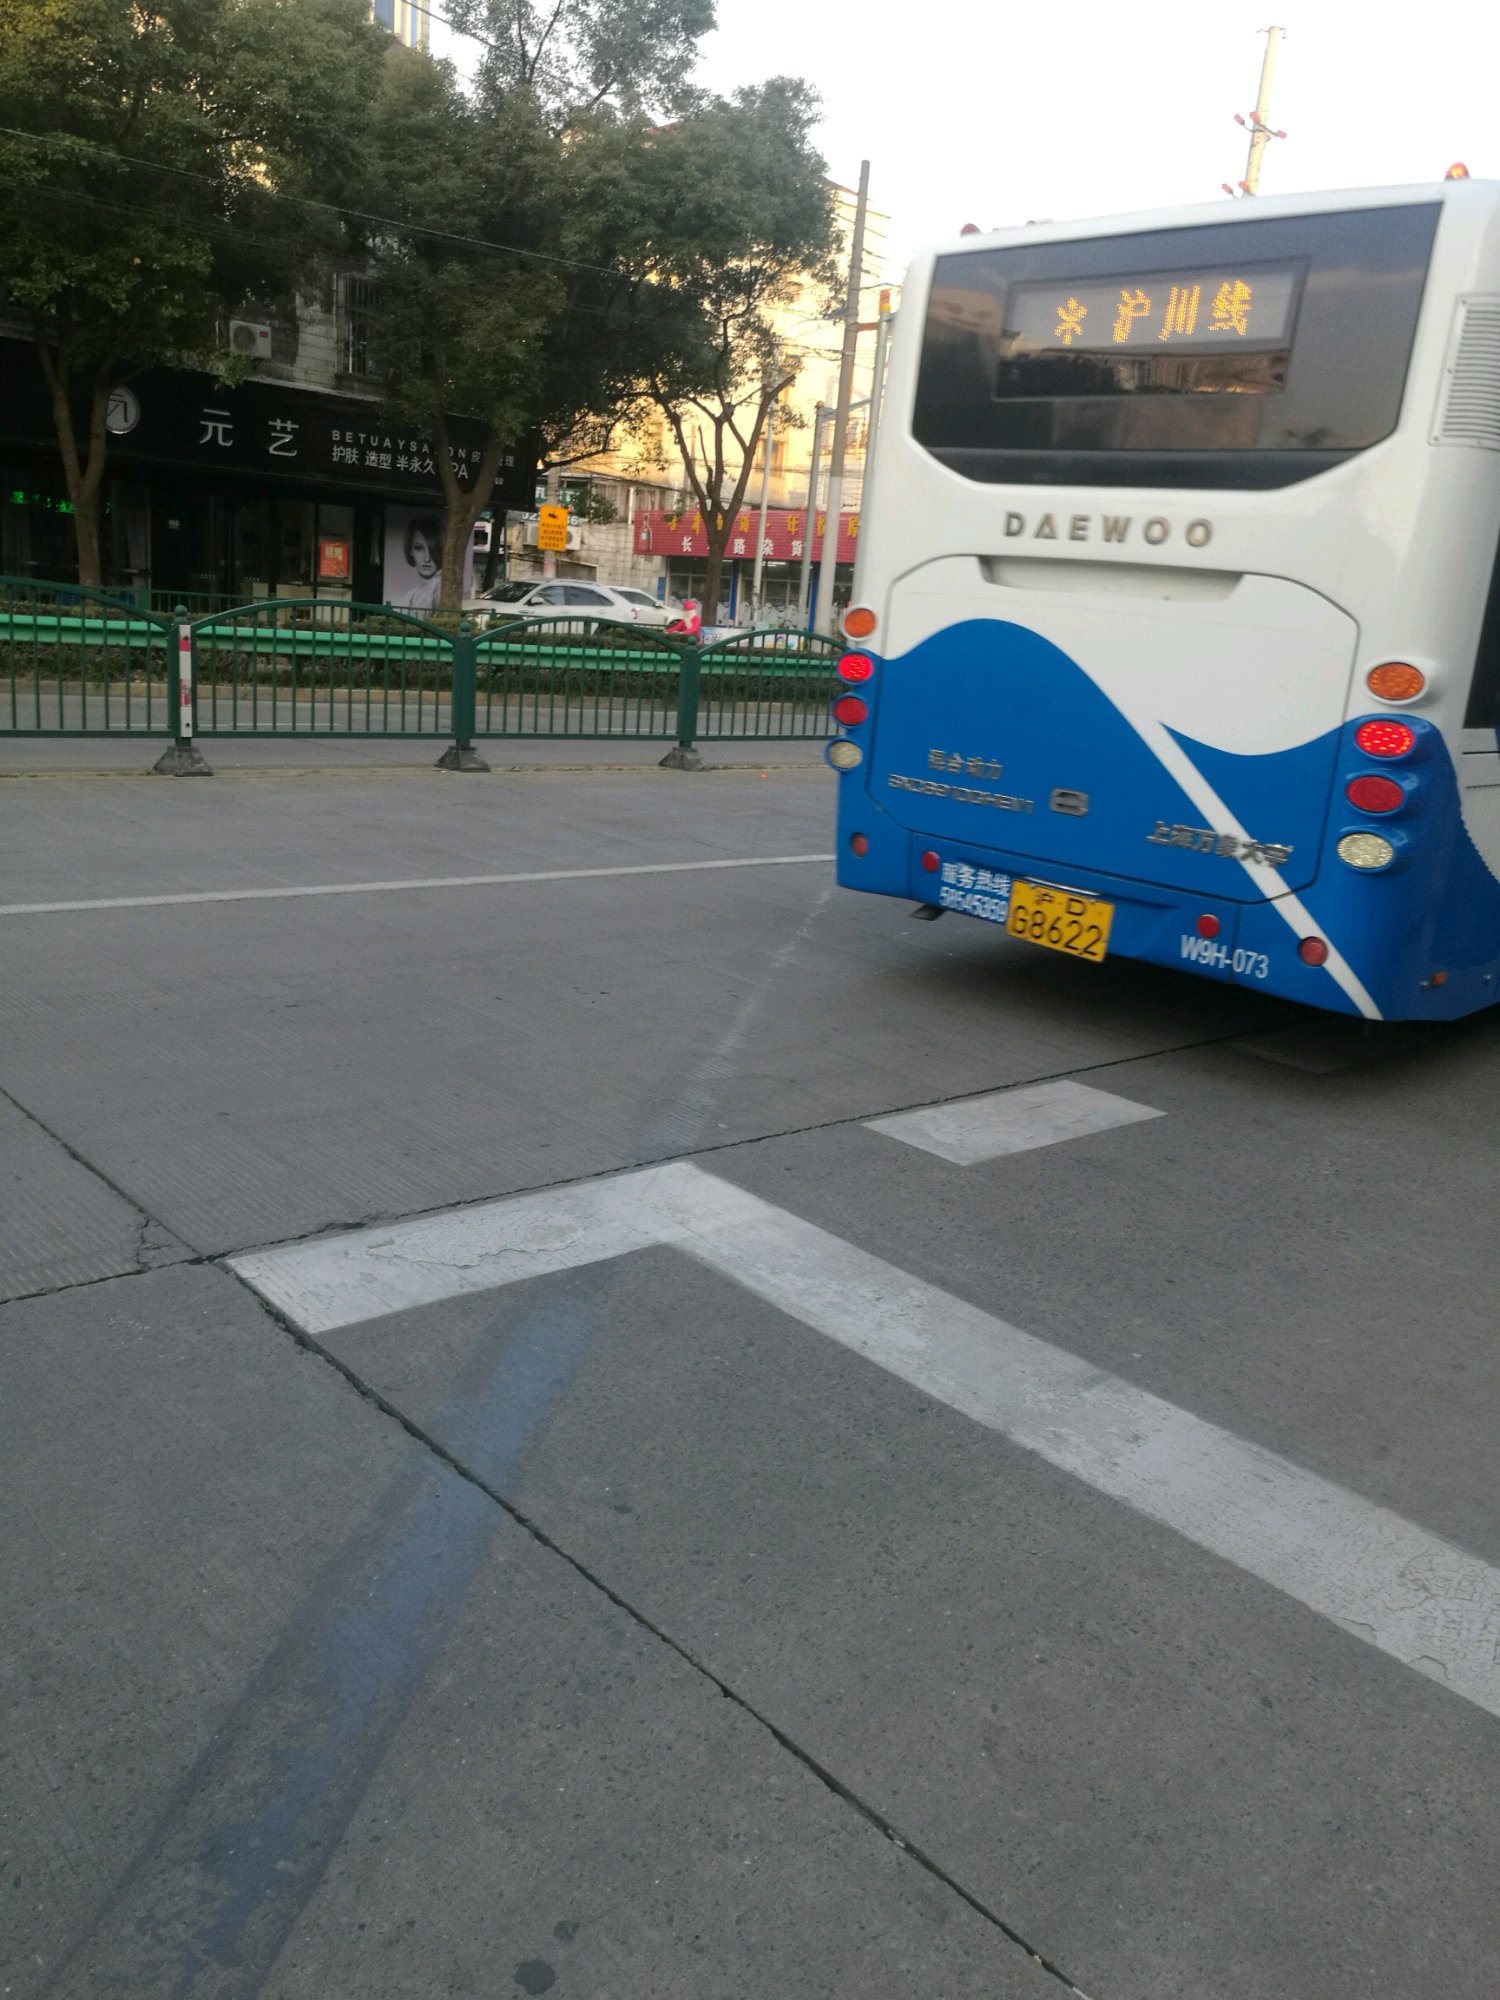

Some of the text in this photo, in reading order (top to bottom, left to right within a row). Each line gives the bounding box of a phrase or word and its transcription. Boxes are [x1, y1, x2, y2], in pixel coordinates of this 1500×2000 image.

[199, 408, 301, 458] 元艺
[331, 430, 467, 459] BETUAYSAON
[364, 450, 392, 470] 造型
[1003, 510, 1215, 548] DAEWOO
[941, 862, 1012, 898] 服务热线
[1011, 904, 1104, 957] G8622
[1180, 934, 1270, 980] W9H-073
